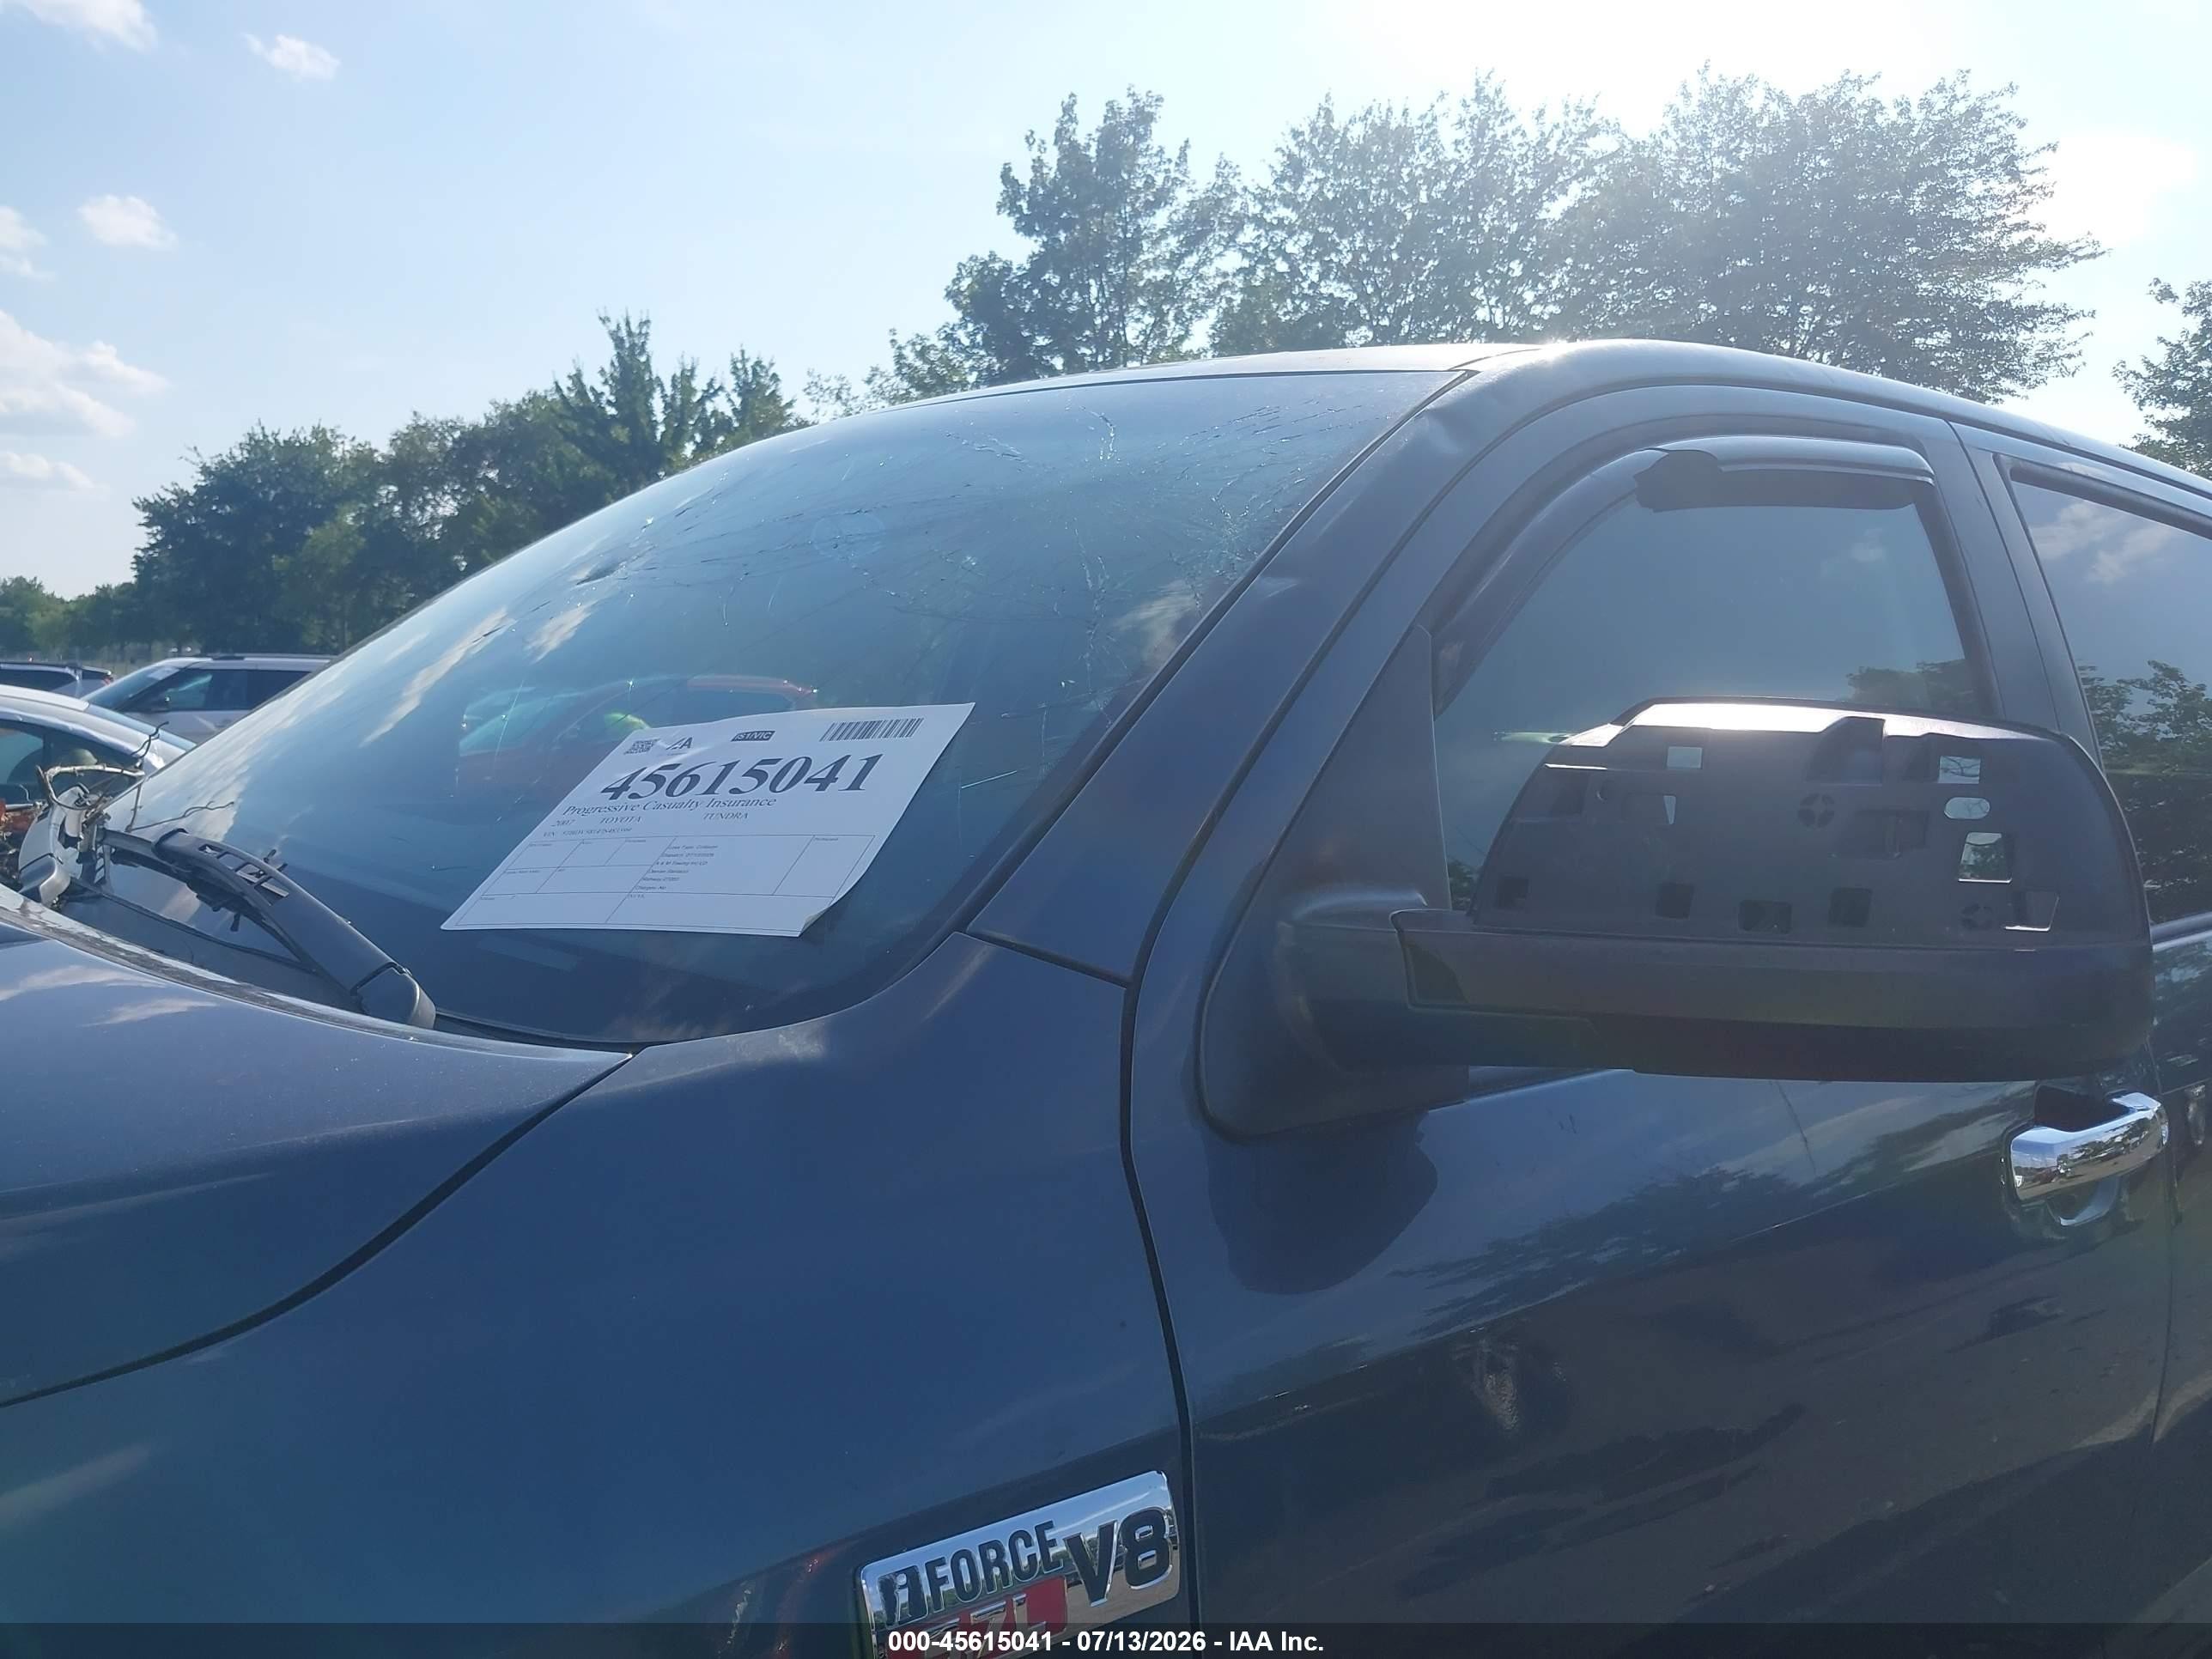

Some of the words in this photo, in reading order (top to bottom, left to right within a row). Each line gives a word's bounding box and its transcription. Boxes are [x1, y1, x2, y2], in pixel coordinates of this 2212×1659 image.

[602, 754, 884, 799] 45615041
[562, 802, 640, 816] Progressive
[643, 799, 700, 811] Casualty
[706, 798, 776, 807] Insurance
[600, 816, 642, 824] TOYOTA
[703, 811, 749, 820] TUNDRA
[1063, 1506, 1173, 1608] V8
